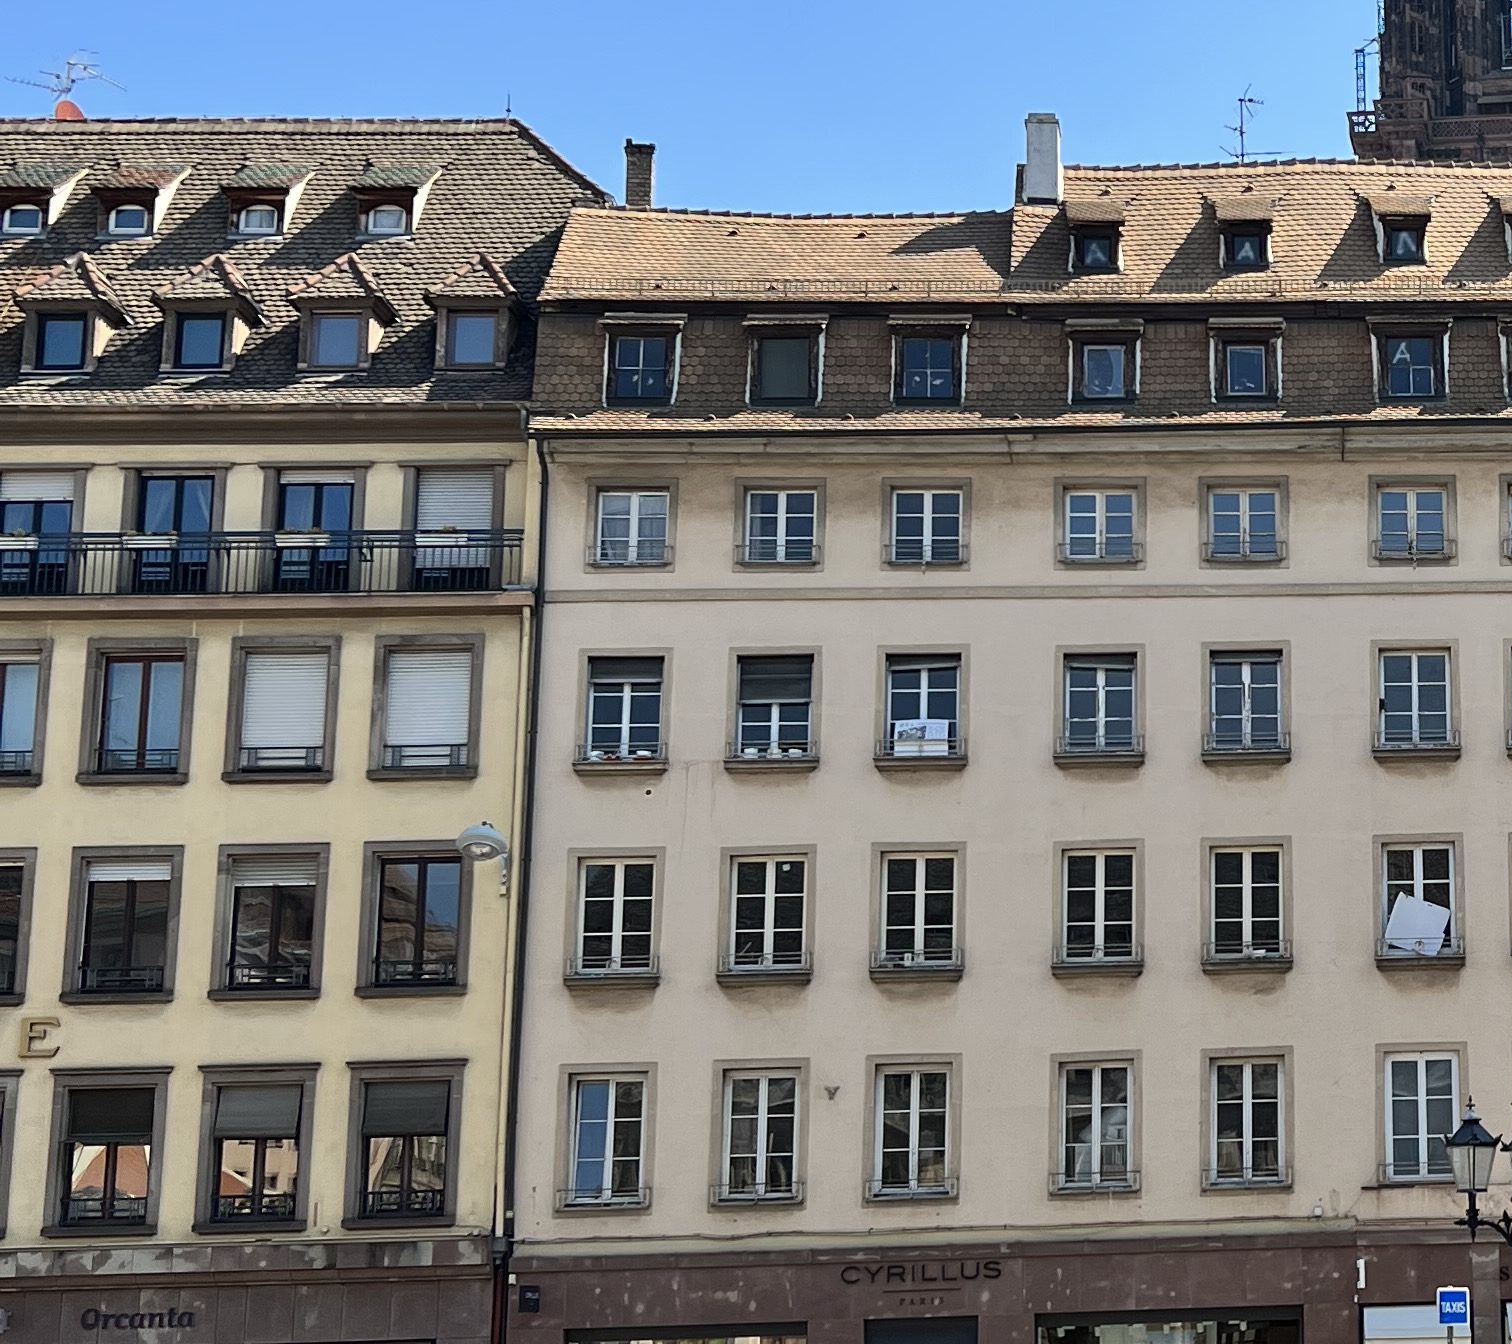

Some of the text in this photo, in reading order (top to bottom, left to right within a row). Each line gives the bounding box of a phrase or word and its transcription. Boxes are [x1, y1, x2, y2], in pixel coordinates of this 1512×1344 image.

[18, 1016, 62, 1059] E
[840, 1260, 1002, 1284] CYRILLUS
[899, 1296, 945, 1306] PARIS
[1440, 1301, 1466, 1314] TAXIS
[80, 1307, 196, 1330] Orcanta
